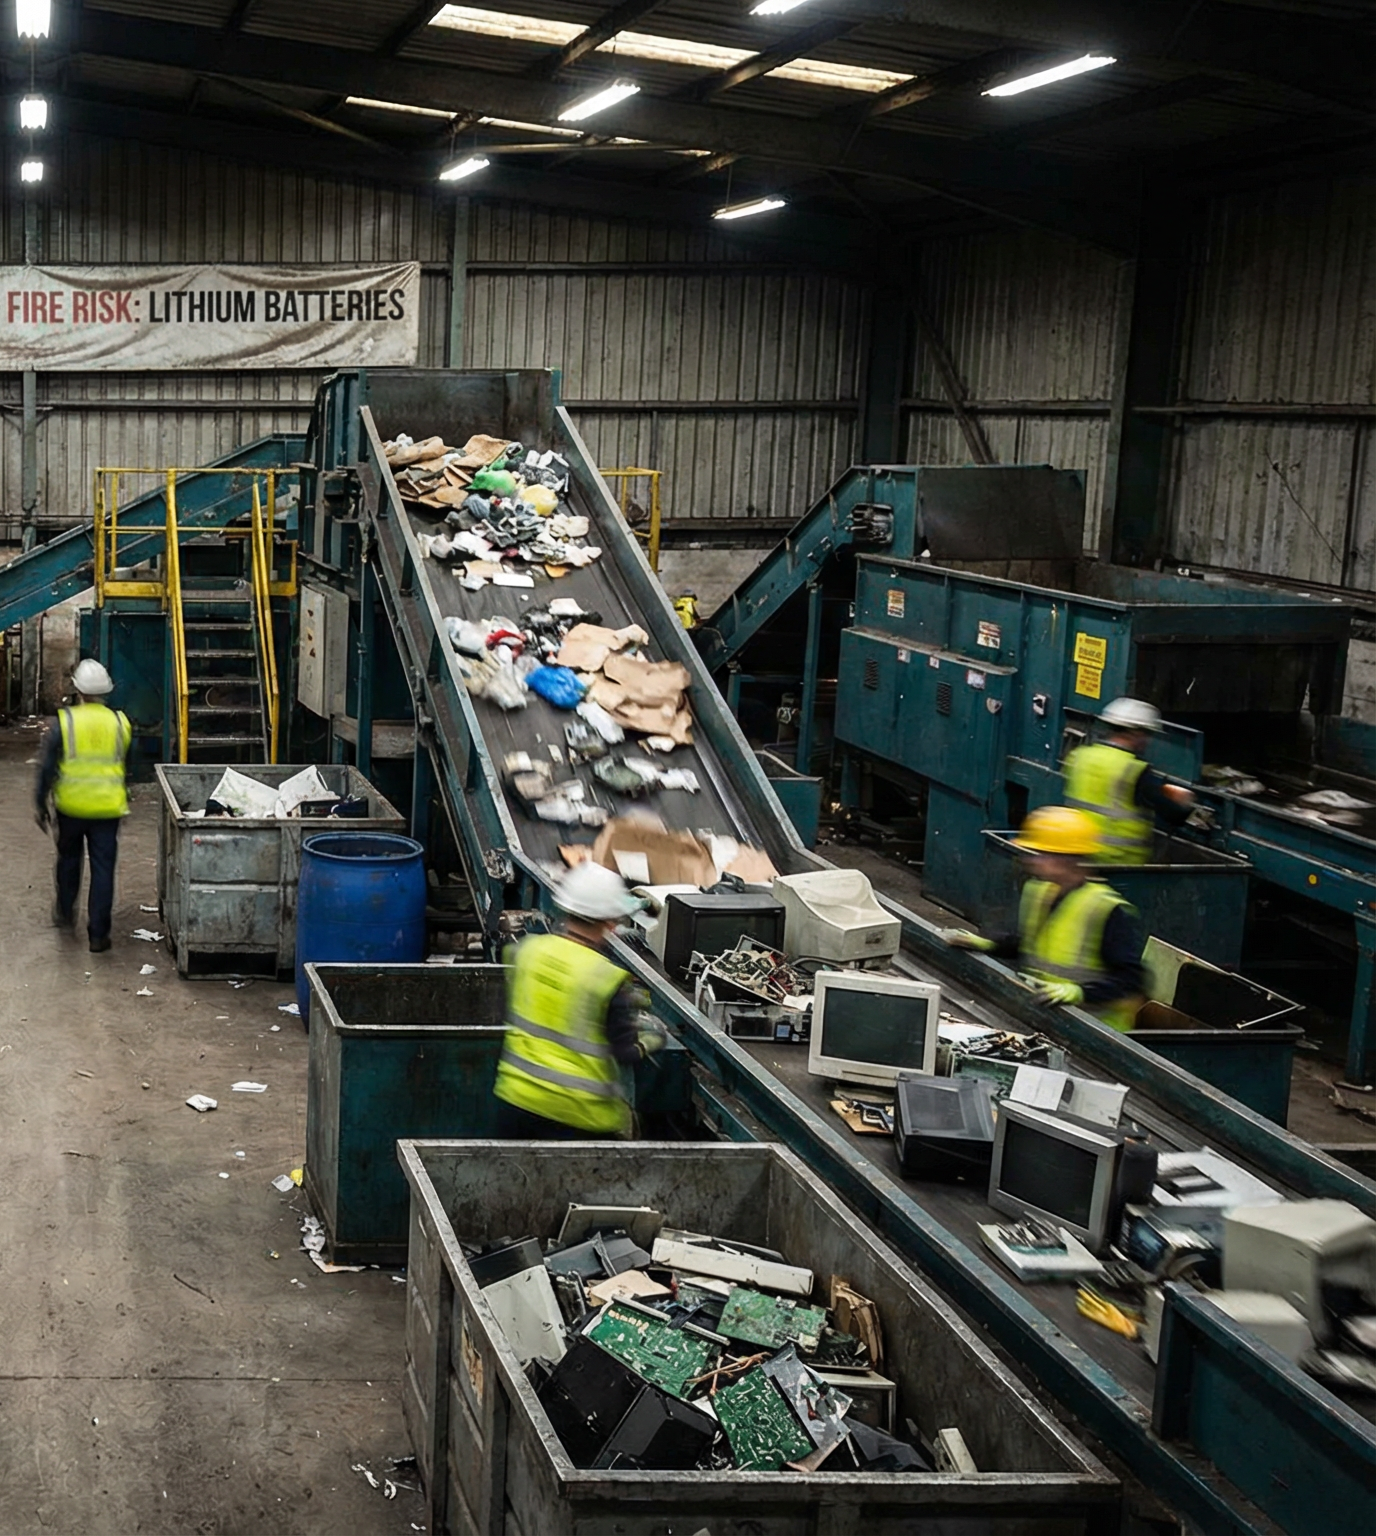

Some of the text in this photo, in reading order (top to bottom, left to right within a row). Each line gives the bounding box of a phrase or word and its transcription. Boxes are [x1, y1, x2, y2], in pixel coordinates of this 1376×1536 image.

[7, 291, 64, 323] FIRE
[73, 291, 141, 323] RISK:
[149, 291, 255, 322] LITHIUM
[265, 289, 405, 322] BATTERIES
